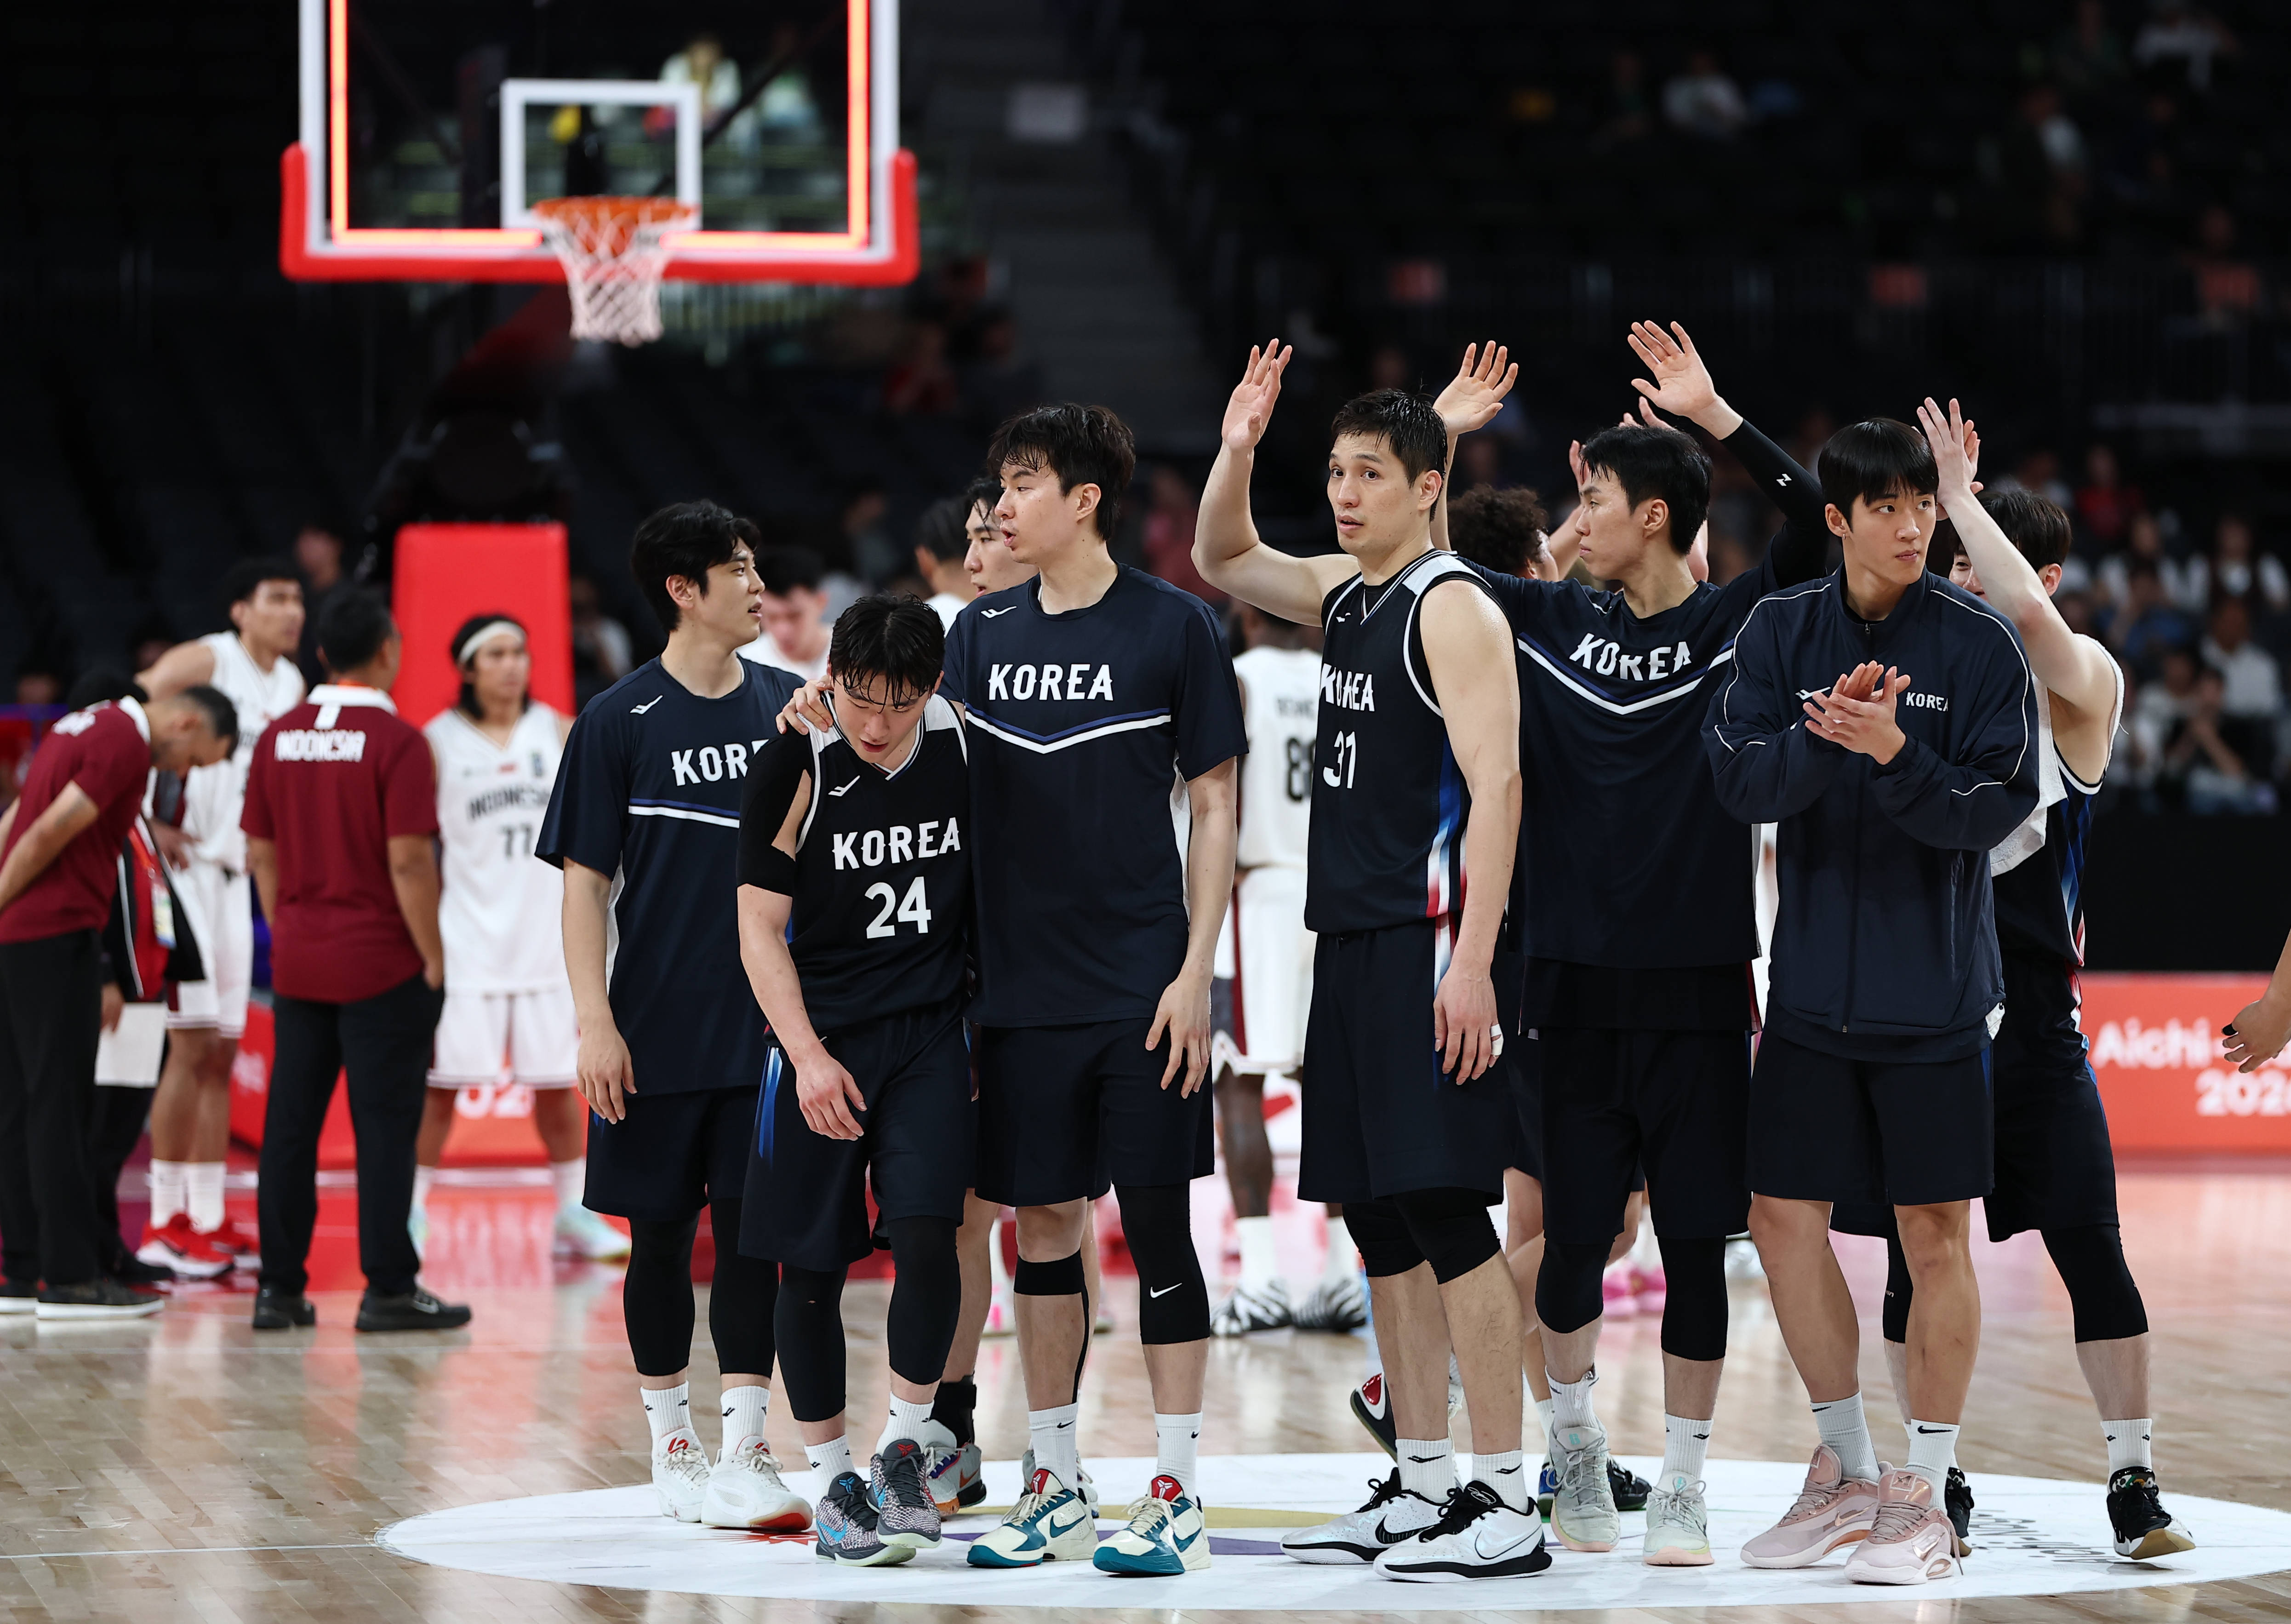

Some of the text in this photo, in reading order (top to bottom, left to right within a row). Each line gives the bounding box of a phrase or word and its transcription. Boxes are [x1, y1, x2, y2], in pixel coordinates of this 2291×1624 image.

[1569, 633, 1692, 681] KOREA
[988, 663, 1114, 701] KOREA
[1320, 663, 1375, 712] KOREA
[671, 738, 770, 787] KOR
[1323, 730, 1356, 789] 31
[831, 817, 961, 870] KOREA
[864, 876, 932, 939] 24
[2195, 1069, 2291, 1117] 202
